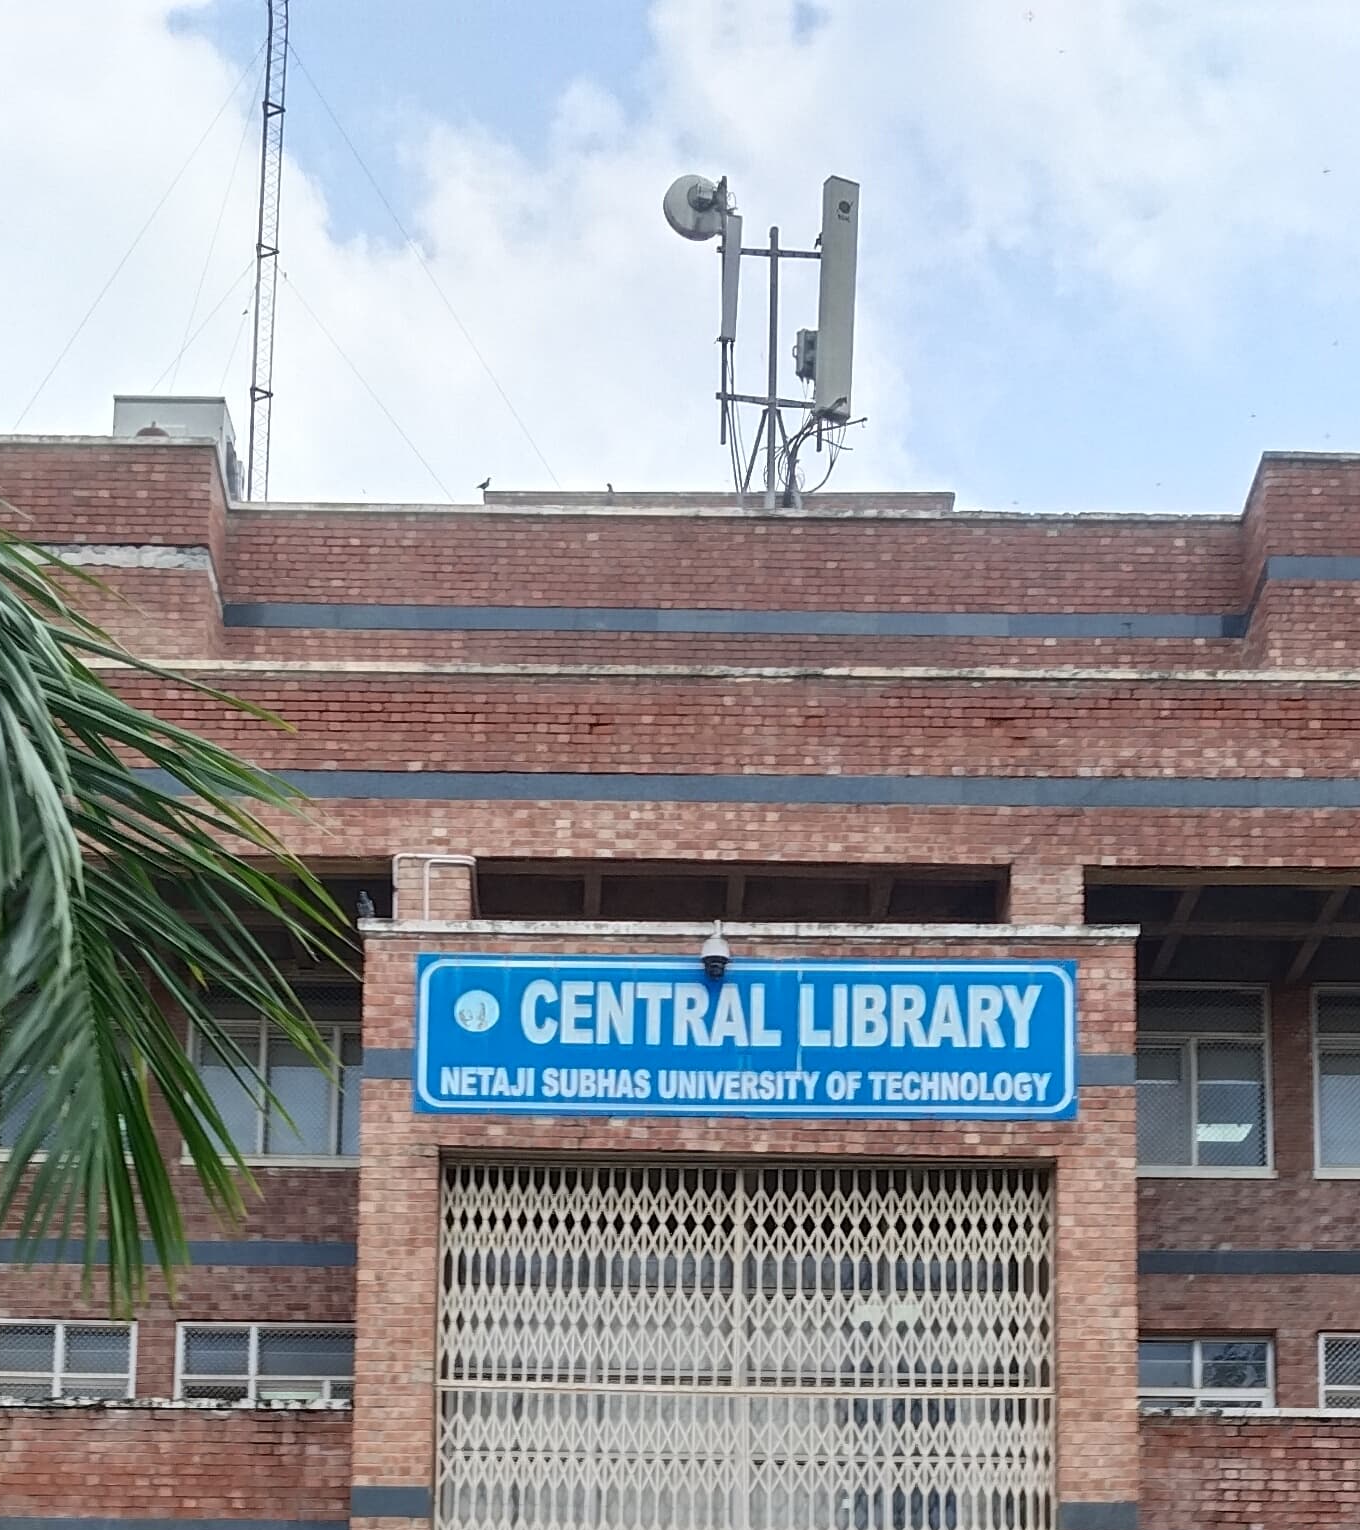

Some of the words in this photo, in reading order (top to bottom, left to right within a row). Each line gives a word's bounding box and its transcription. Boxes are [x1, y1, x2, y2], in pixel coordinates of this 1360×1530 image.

[520, 979, 781, 1047] CENTRAL
[799, 984, 1041, 1048] LIBRARY
[440, 1067, 536, 1099] NETAJI
[542, 1068, 651, 1100] SUBHAS
[658, 1070, 819, 1101] UNIVERSITY
[826, 1071, 861, 1101] OF
[868, 1072, 1051, 1102] TECHNOLOGY
